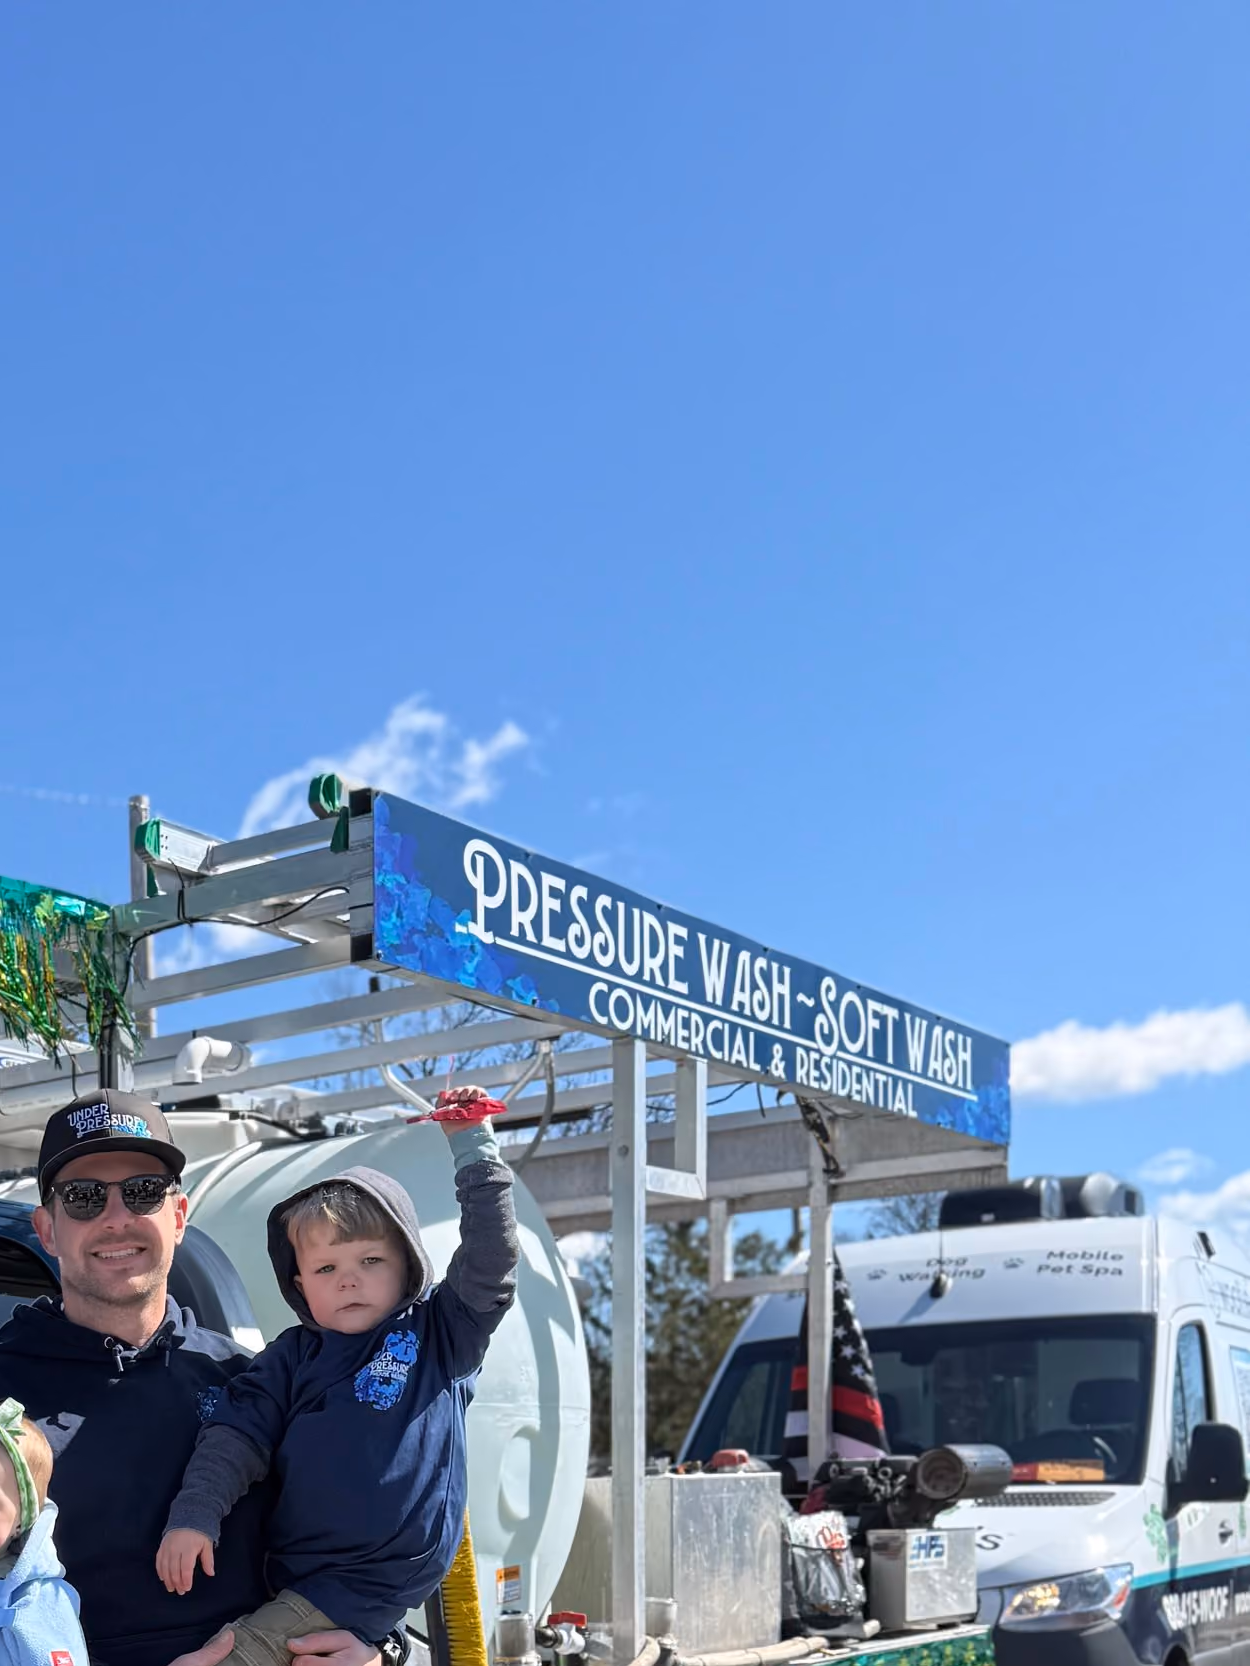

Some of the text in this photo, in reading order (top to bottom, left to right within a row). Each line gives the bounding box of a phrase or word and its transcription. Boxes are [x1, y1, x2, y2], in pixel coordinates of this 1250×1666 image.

[463, 838, 689, 995] PRESSURE
[696, 932, 791, 1030] WASH
[814, 976, 900, 1065] SOFT
[904, 1012, 972, 1091] WASH
[588, 981, 918, 1118] COMMERCIAL & RESIDENTIAL
[67, 1103, 110, 1127] UNDER
[1046, 1249, 1124, 1261] Mobile
[1036, 1264, 1124, 1278] Pet Spa
